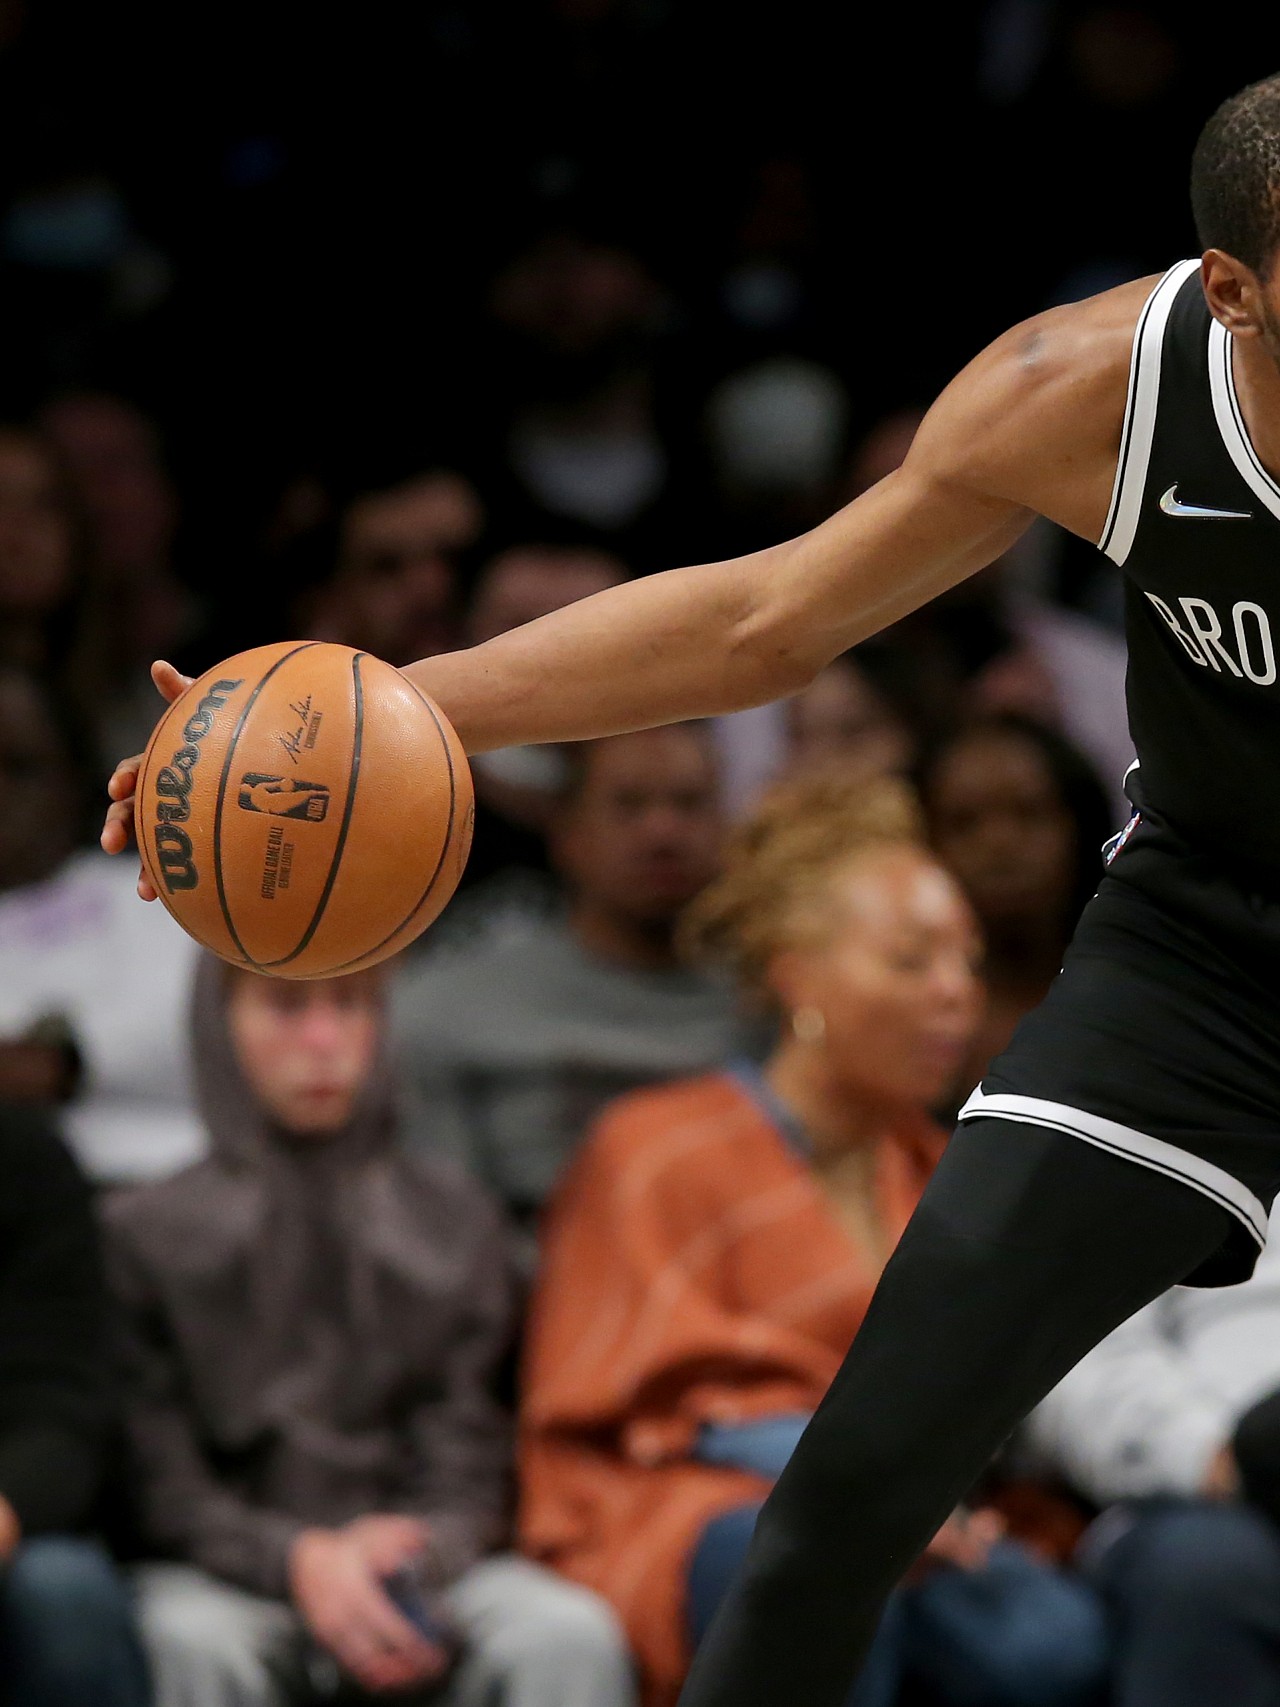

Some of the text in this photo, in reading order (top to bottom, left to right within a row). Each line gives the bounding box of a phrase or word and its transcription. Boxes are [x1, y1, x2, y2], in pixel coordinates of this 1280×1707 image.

[155, 679, 246, 895] Wilson
[306, 798, 325, 819] NBA
[261, 826, 284, 900] OFFICIAL GAME BALL
